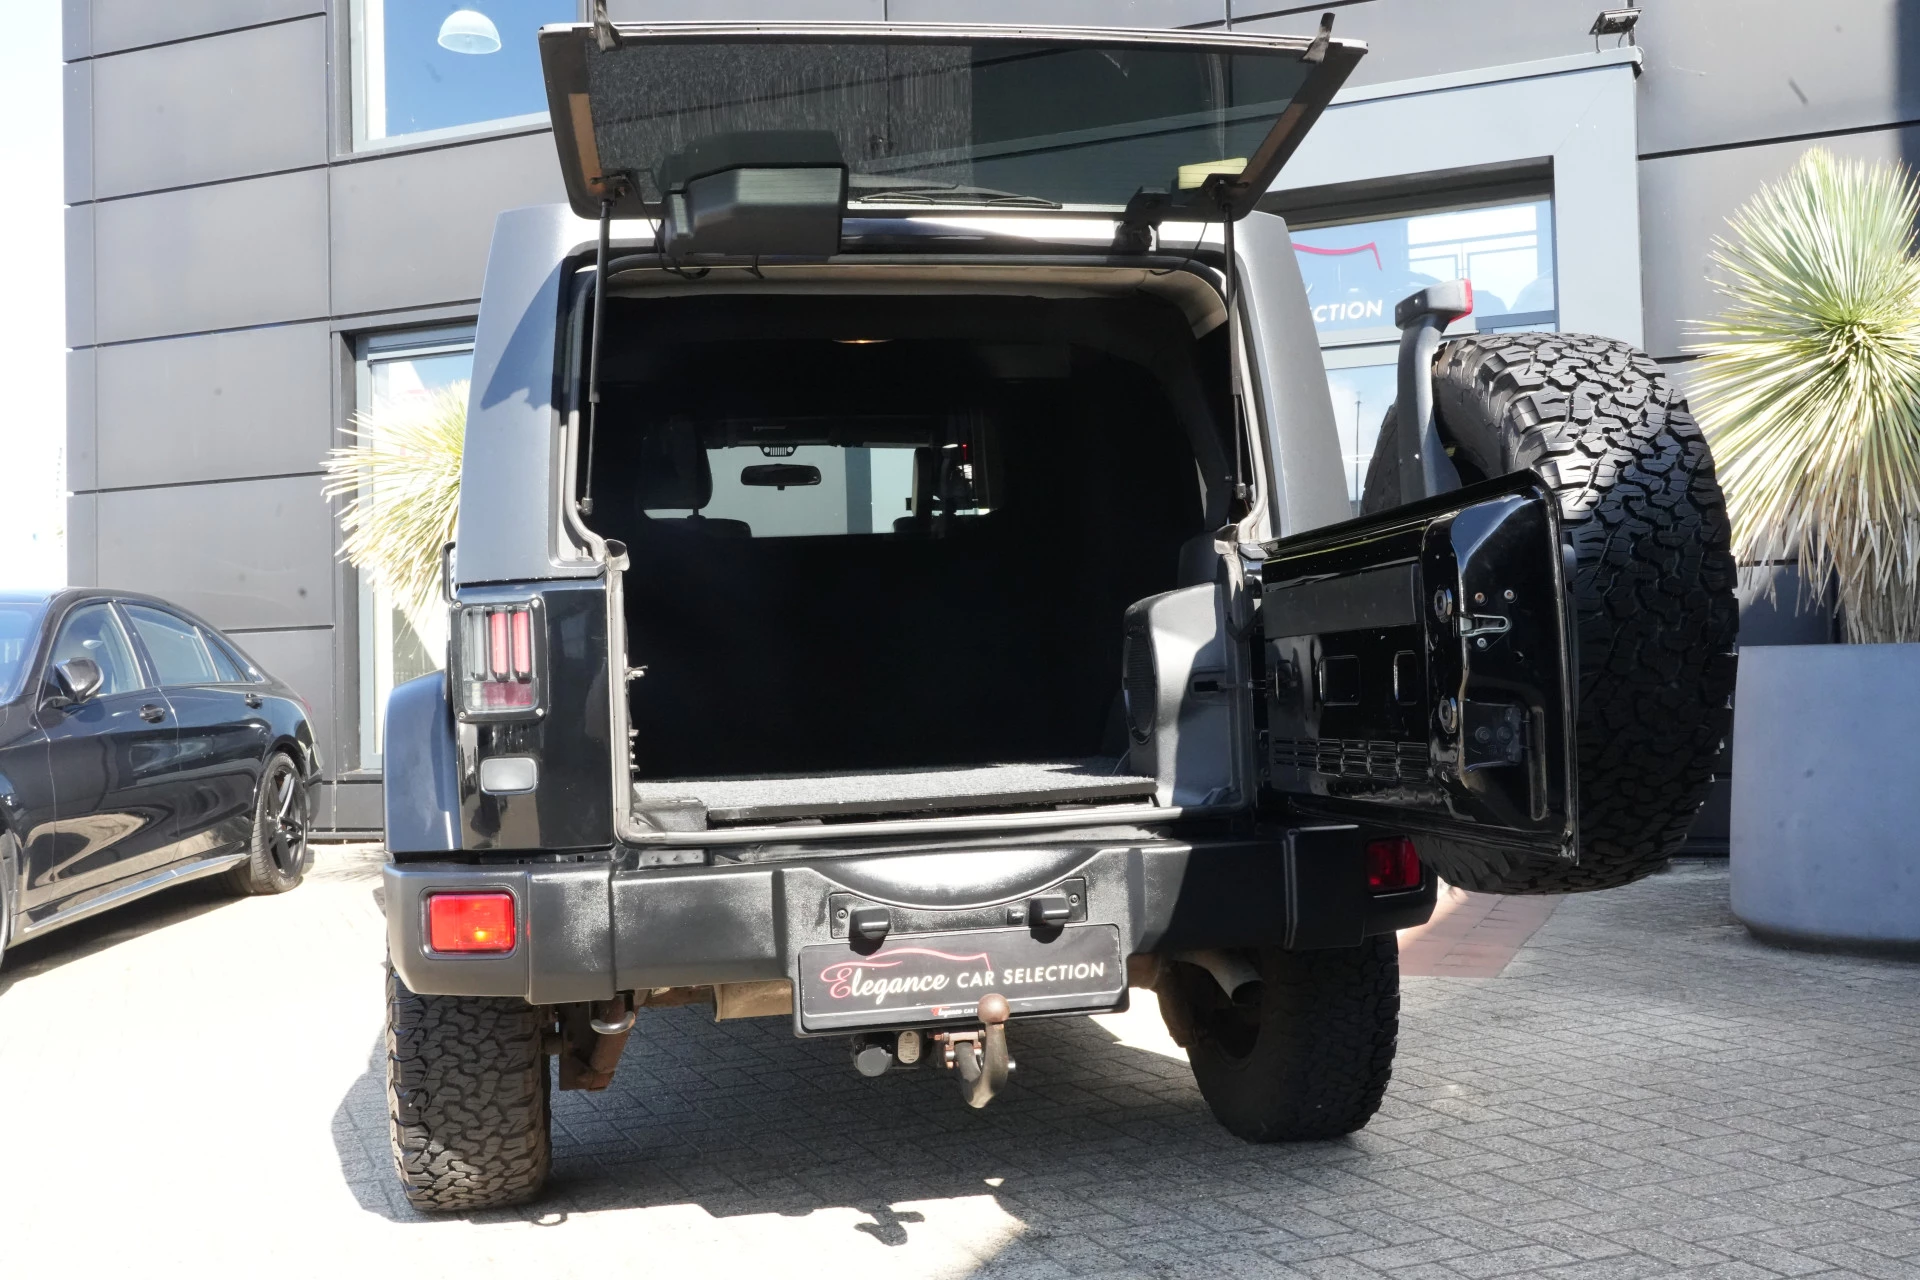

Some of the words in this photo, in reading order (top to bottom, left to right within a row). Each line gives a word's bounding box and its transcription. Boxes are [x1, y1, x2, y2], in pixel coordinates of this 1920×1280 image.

[1310, 300, 1383, 323] CTION
[820, 960, 950, 1005] Elegance
[956, 970, 995, 988] CAR
[1002, 961, 1104, 985] SELECTION
